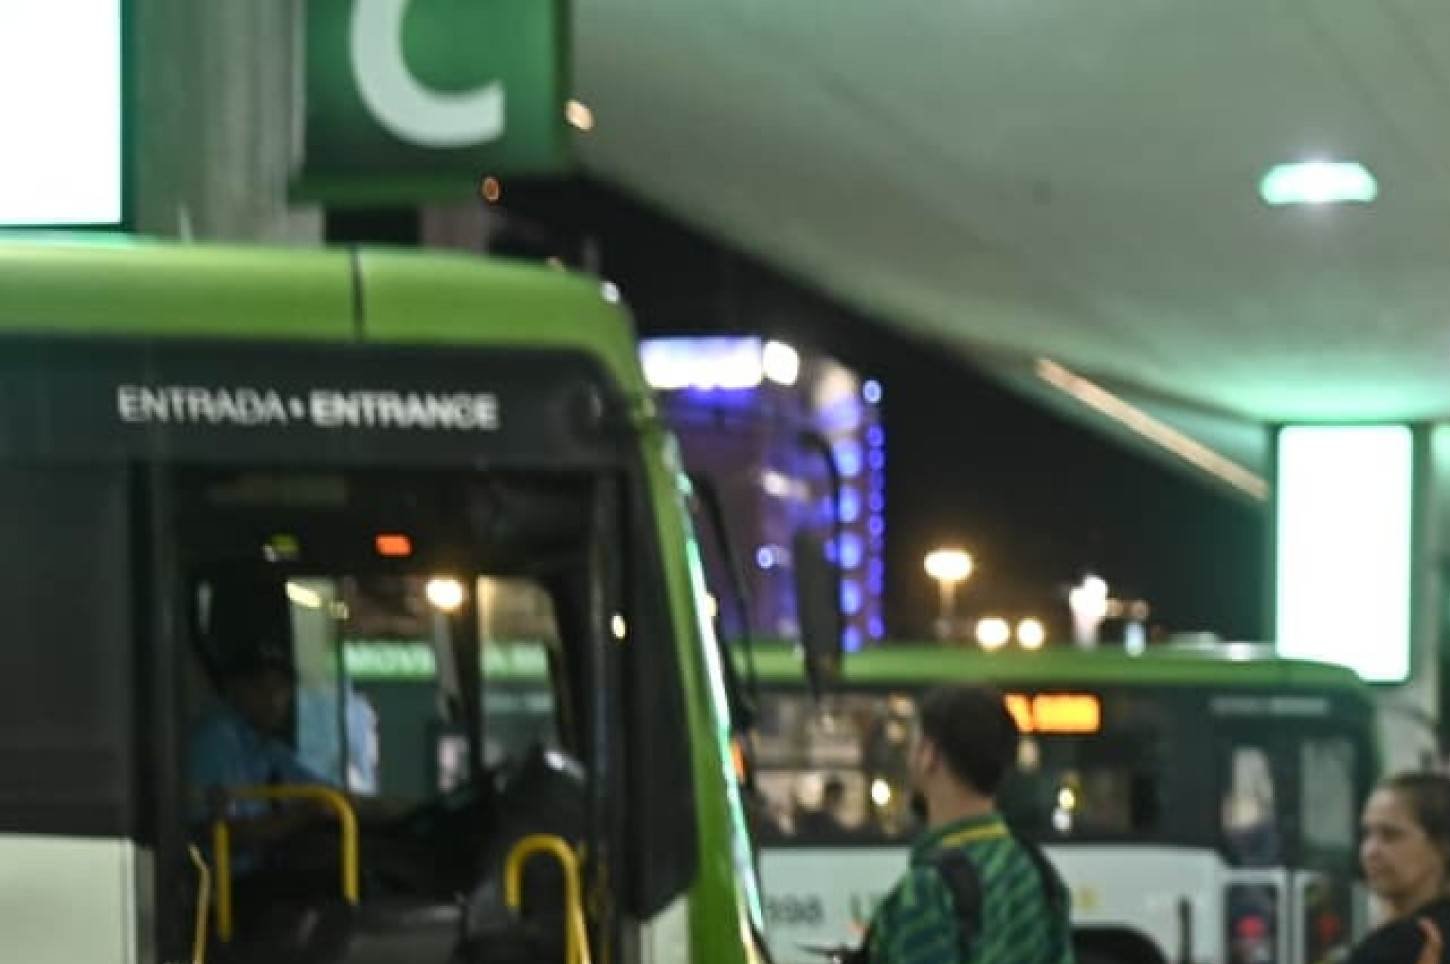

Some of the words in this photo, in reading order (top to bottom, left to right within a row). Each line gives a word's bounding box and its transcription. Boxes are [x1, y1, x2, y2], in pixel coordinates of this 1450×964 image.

[351, 0, 504, 148] C
[117, 385, 289, 423] ENTRADA
[310, 390, 499, 429] ENTRANCE
